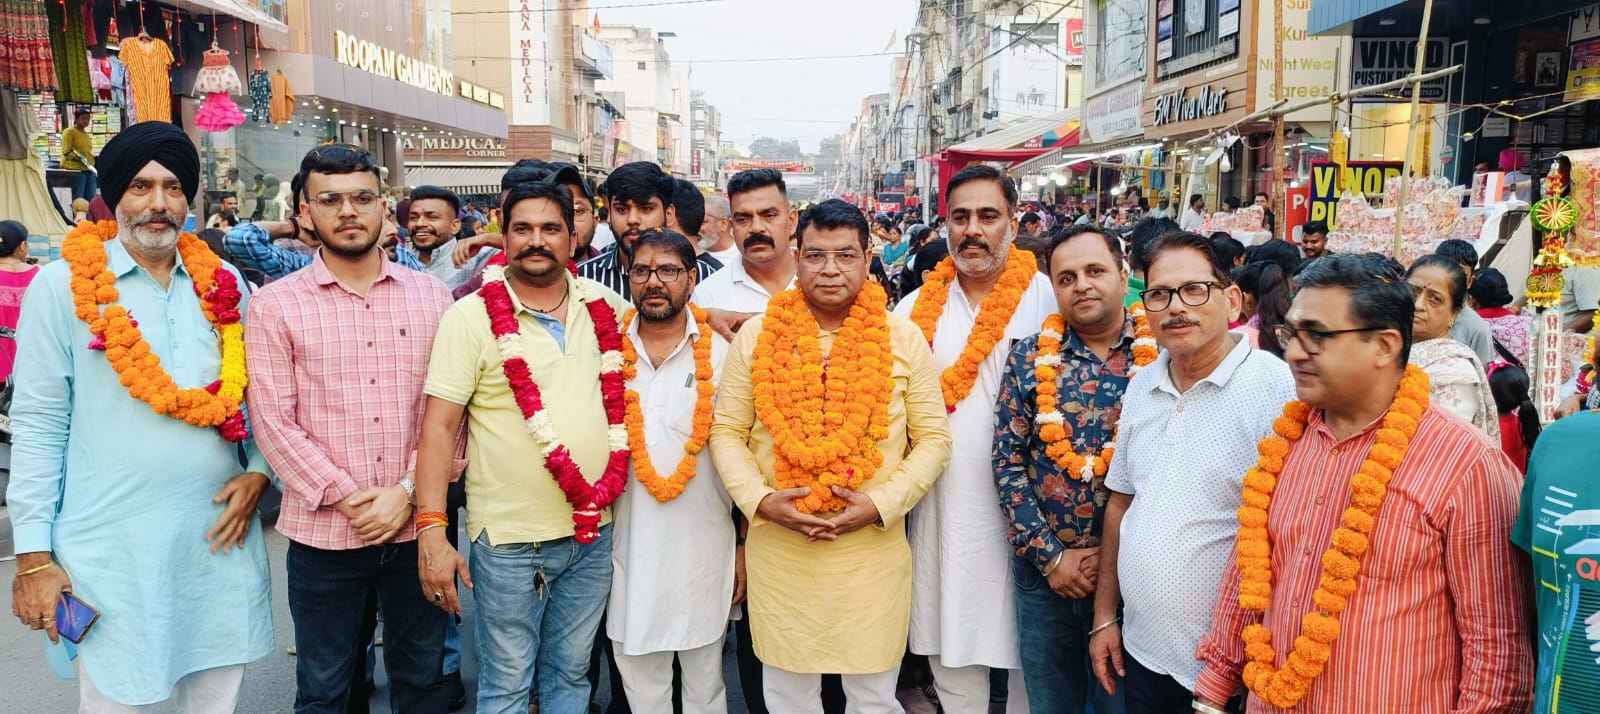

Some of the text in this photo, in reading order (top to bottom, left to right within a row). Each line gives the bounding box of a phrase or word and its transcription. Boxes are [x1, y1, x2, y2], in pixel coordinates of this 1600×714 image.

[520, 0, 532, 103] ANA MEDICAL
[1360, 41, 1444, 69] VINOD
[334, 29, 396, 80] ROOPAM
[396, 53, 454, 97] GARMENTS
[1259, 58, 1297, 71] Niht
[1354, 70, 1394, 86] PUSTAK
[1268, 83, 1329, 99] Sarees
[1152, 95, 1171, 127] BM
[1172, 86, 1195, 122] Viva
[1197, 84, 1228, 118] Mart
[424, 137, 506, 150] MEDICAL
[466, 150, 507, 158] CORNER
[1313, 166, 1401, 199] VINO
